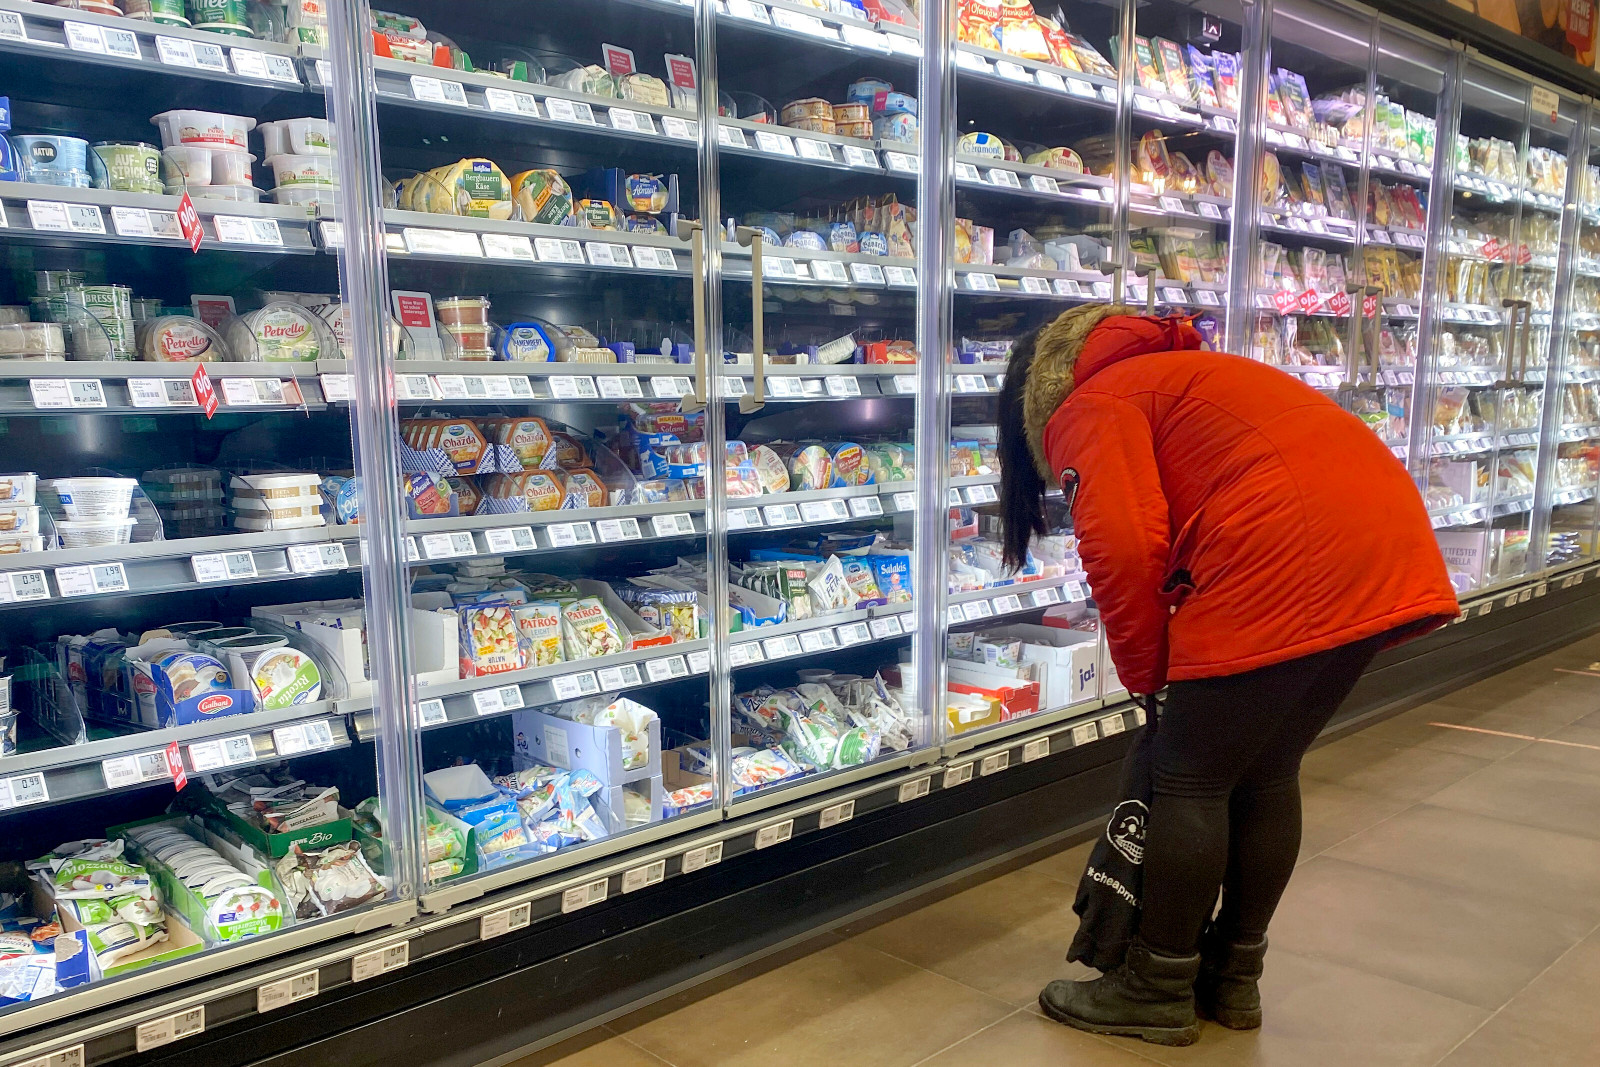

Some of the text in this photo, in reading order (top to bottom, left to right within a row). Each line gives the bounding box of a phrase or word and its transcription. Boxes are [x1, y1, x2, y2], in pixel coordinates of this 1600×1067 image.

[1570, 0, 1591, 19] REWE
[32, 147, 54, 157] NATUR
[963, 138, 1001, 154] Géramont
[115, 154, 140, 165] AUF-
[1052, 153, 1079, 168] Géramont
[111, 165, 146, 179] STRICH
[465, 174, 500, 184] Bergbauern
[475, 182, 490, 191] Käse
[263, 322, 305, 339] Petrella
[166, 335, 207, 350] Petrella
[82, 383, 97, 392] 1.49
[660, 425, 685, 434] Salami
[443, 435, 476, 448] Obazda
[514, 433, 544, 444] Obazda
[526, 485, 556, 498] Obazda
[105, 566, 120, 577] 1.99
[880, 562, 907, 575] Salakis
[22, 574, 41, 585] 0.99
[826, 575, 842, 597] FETA
[566, 605, 602, 620] PATROS
[520, 616, 558, 629] PATROS
[530, 628, 550, 636] LEICHT
[487, 655, 506, 663] NATUR
[1079, 662, 1095, 691] ja!
[278, 674, 309, 705] Ricotta
[200, 698, 229, 713] Galbani
[21, 777, 40, 789] 0.99
[309, 831, 333, 845] Bio
[1086, 866, 1141, 909] #cheapmo
[60, 1048, 79, 1061] 3.49
